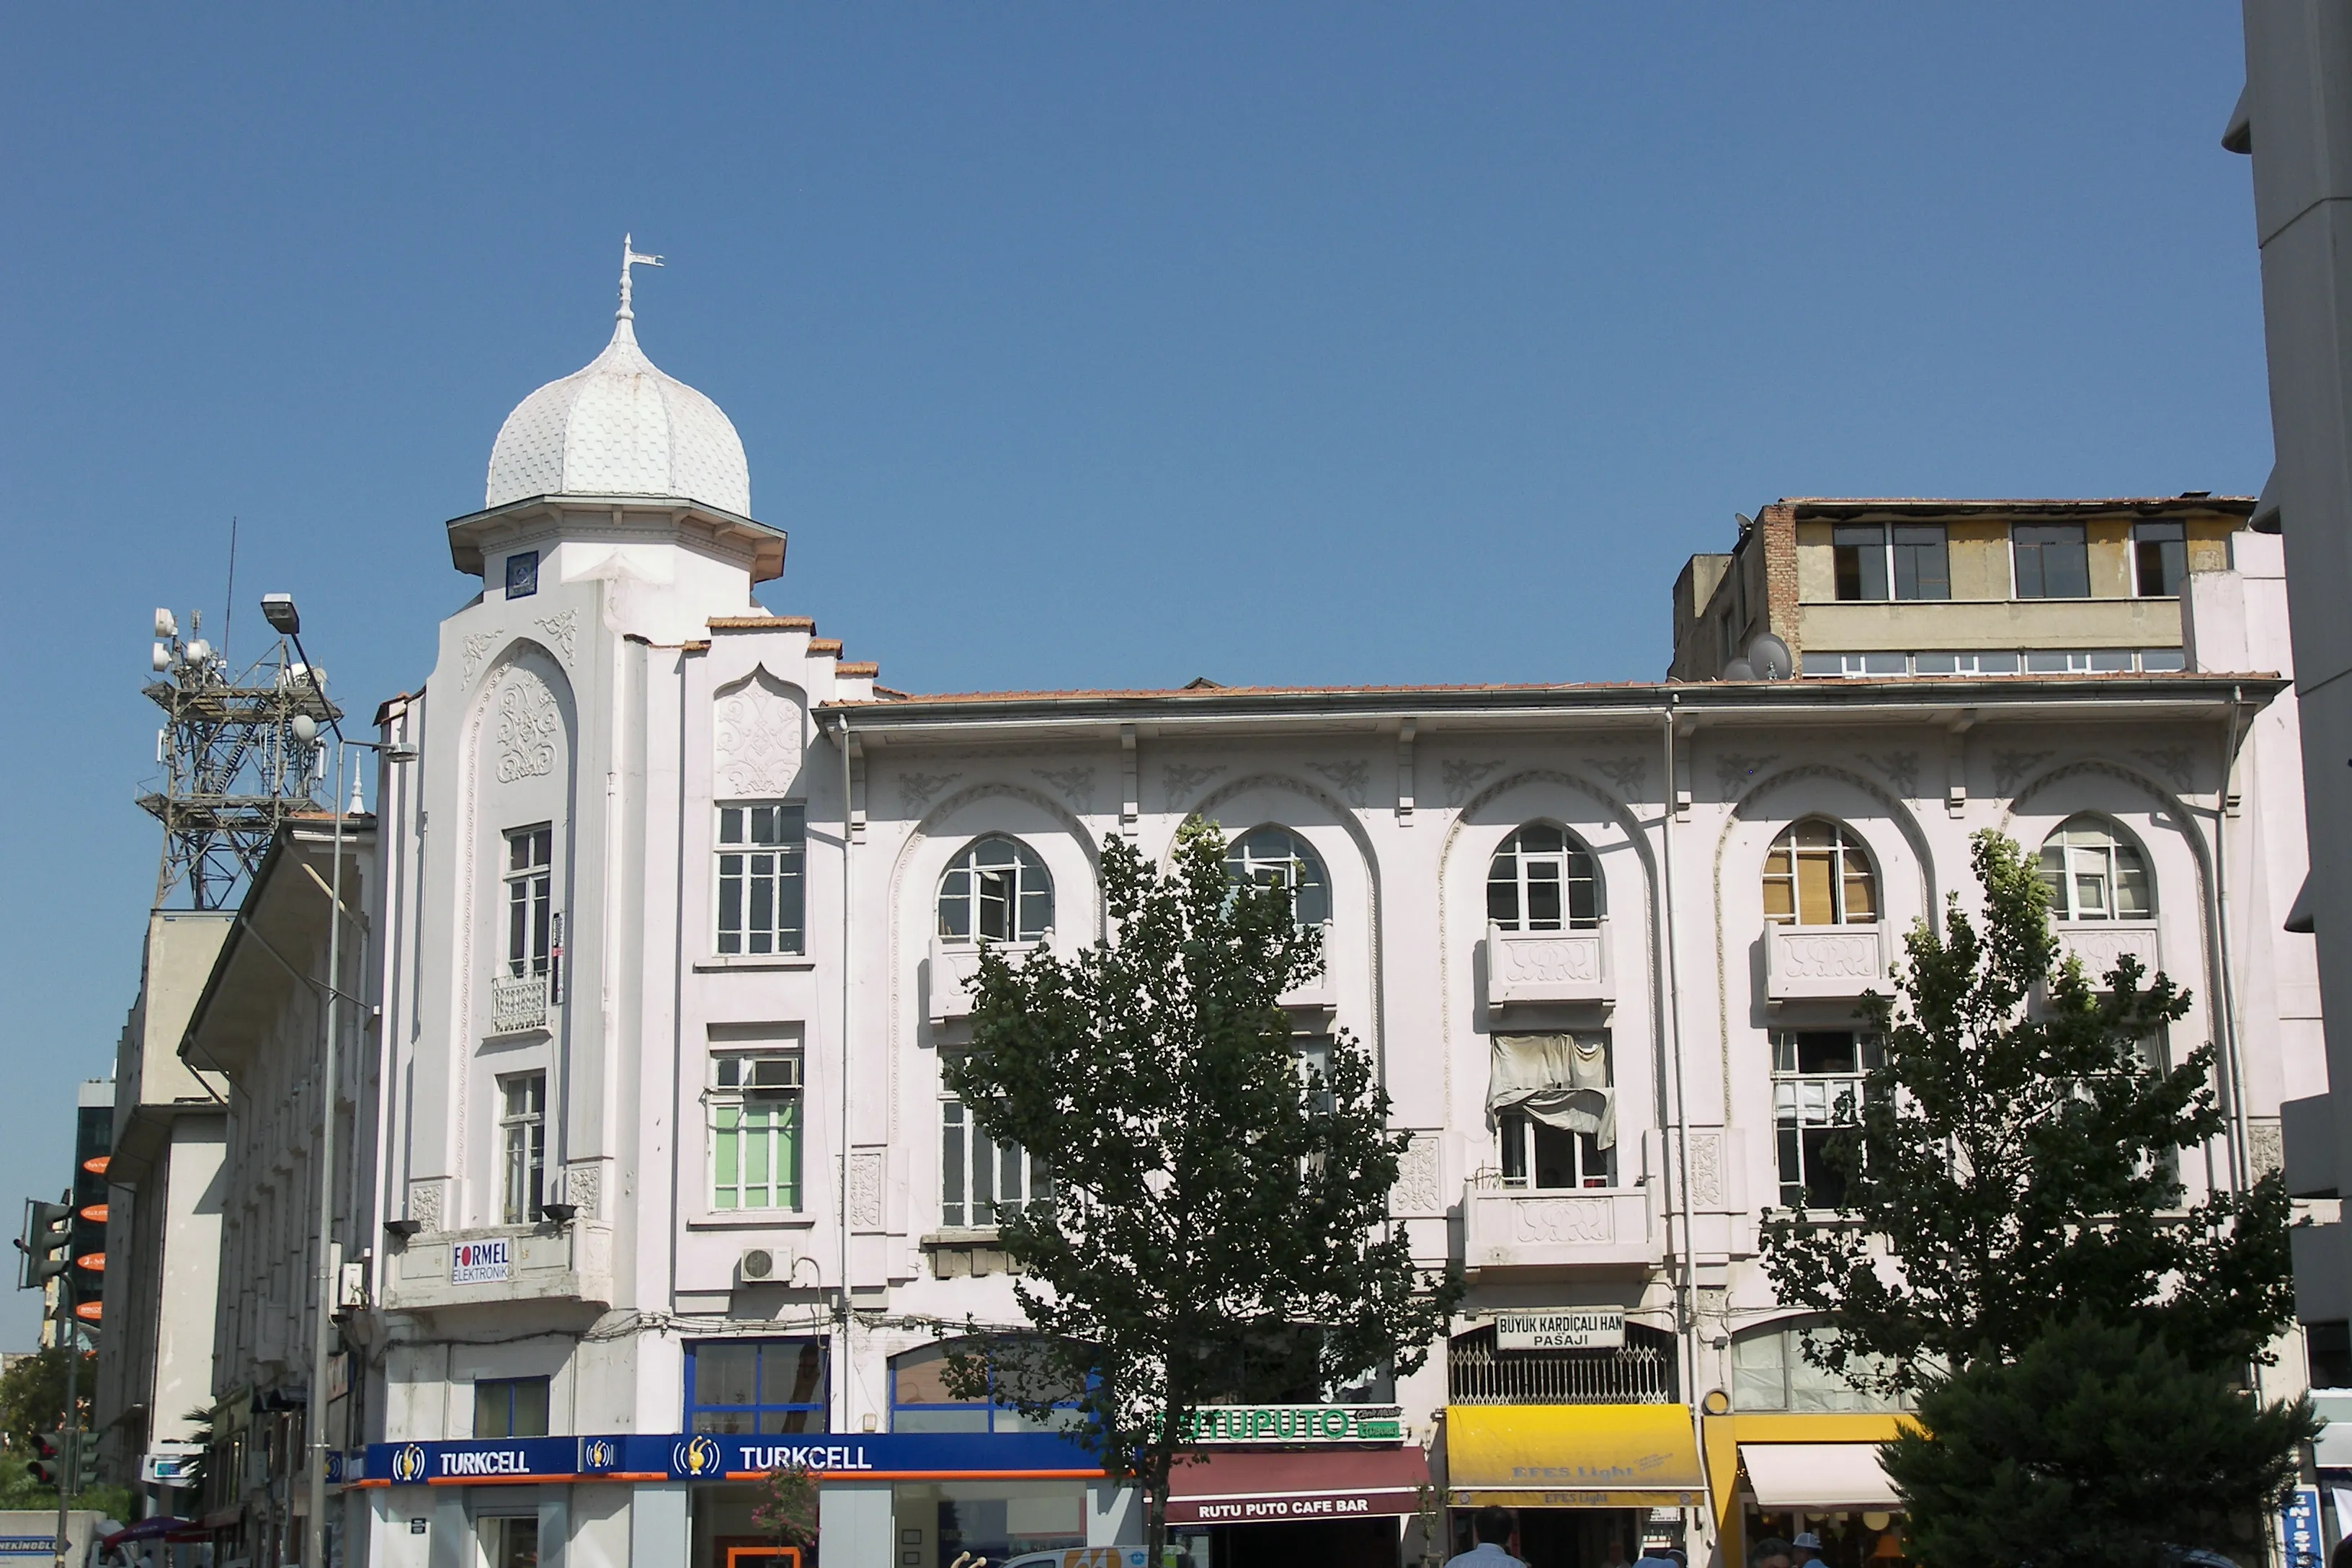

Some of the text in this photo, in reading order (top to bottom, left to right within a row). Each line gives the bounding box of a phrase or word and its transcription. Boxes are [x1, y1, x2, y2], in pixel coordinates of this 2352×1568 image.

[454, 1243, 509, 1268] FORMEL
[1500, 1316, 1537, 1333] BÜYÜK
[1600, 1316, 1622, 1330] HAN
[1534, 1335, 1588, 1346] PASAJI
[440, 1451, 530, 1475] TURKCELL
[739, 1446, 873, 1470] TURKCELL
[1198, 1499, 1368, 1518] RUTU PUTO CAFE BAR
